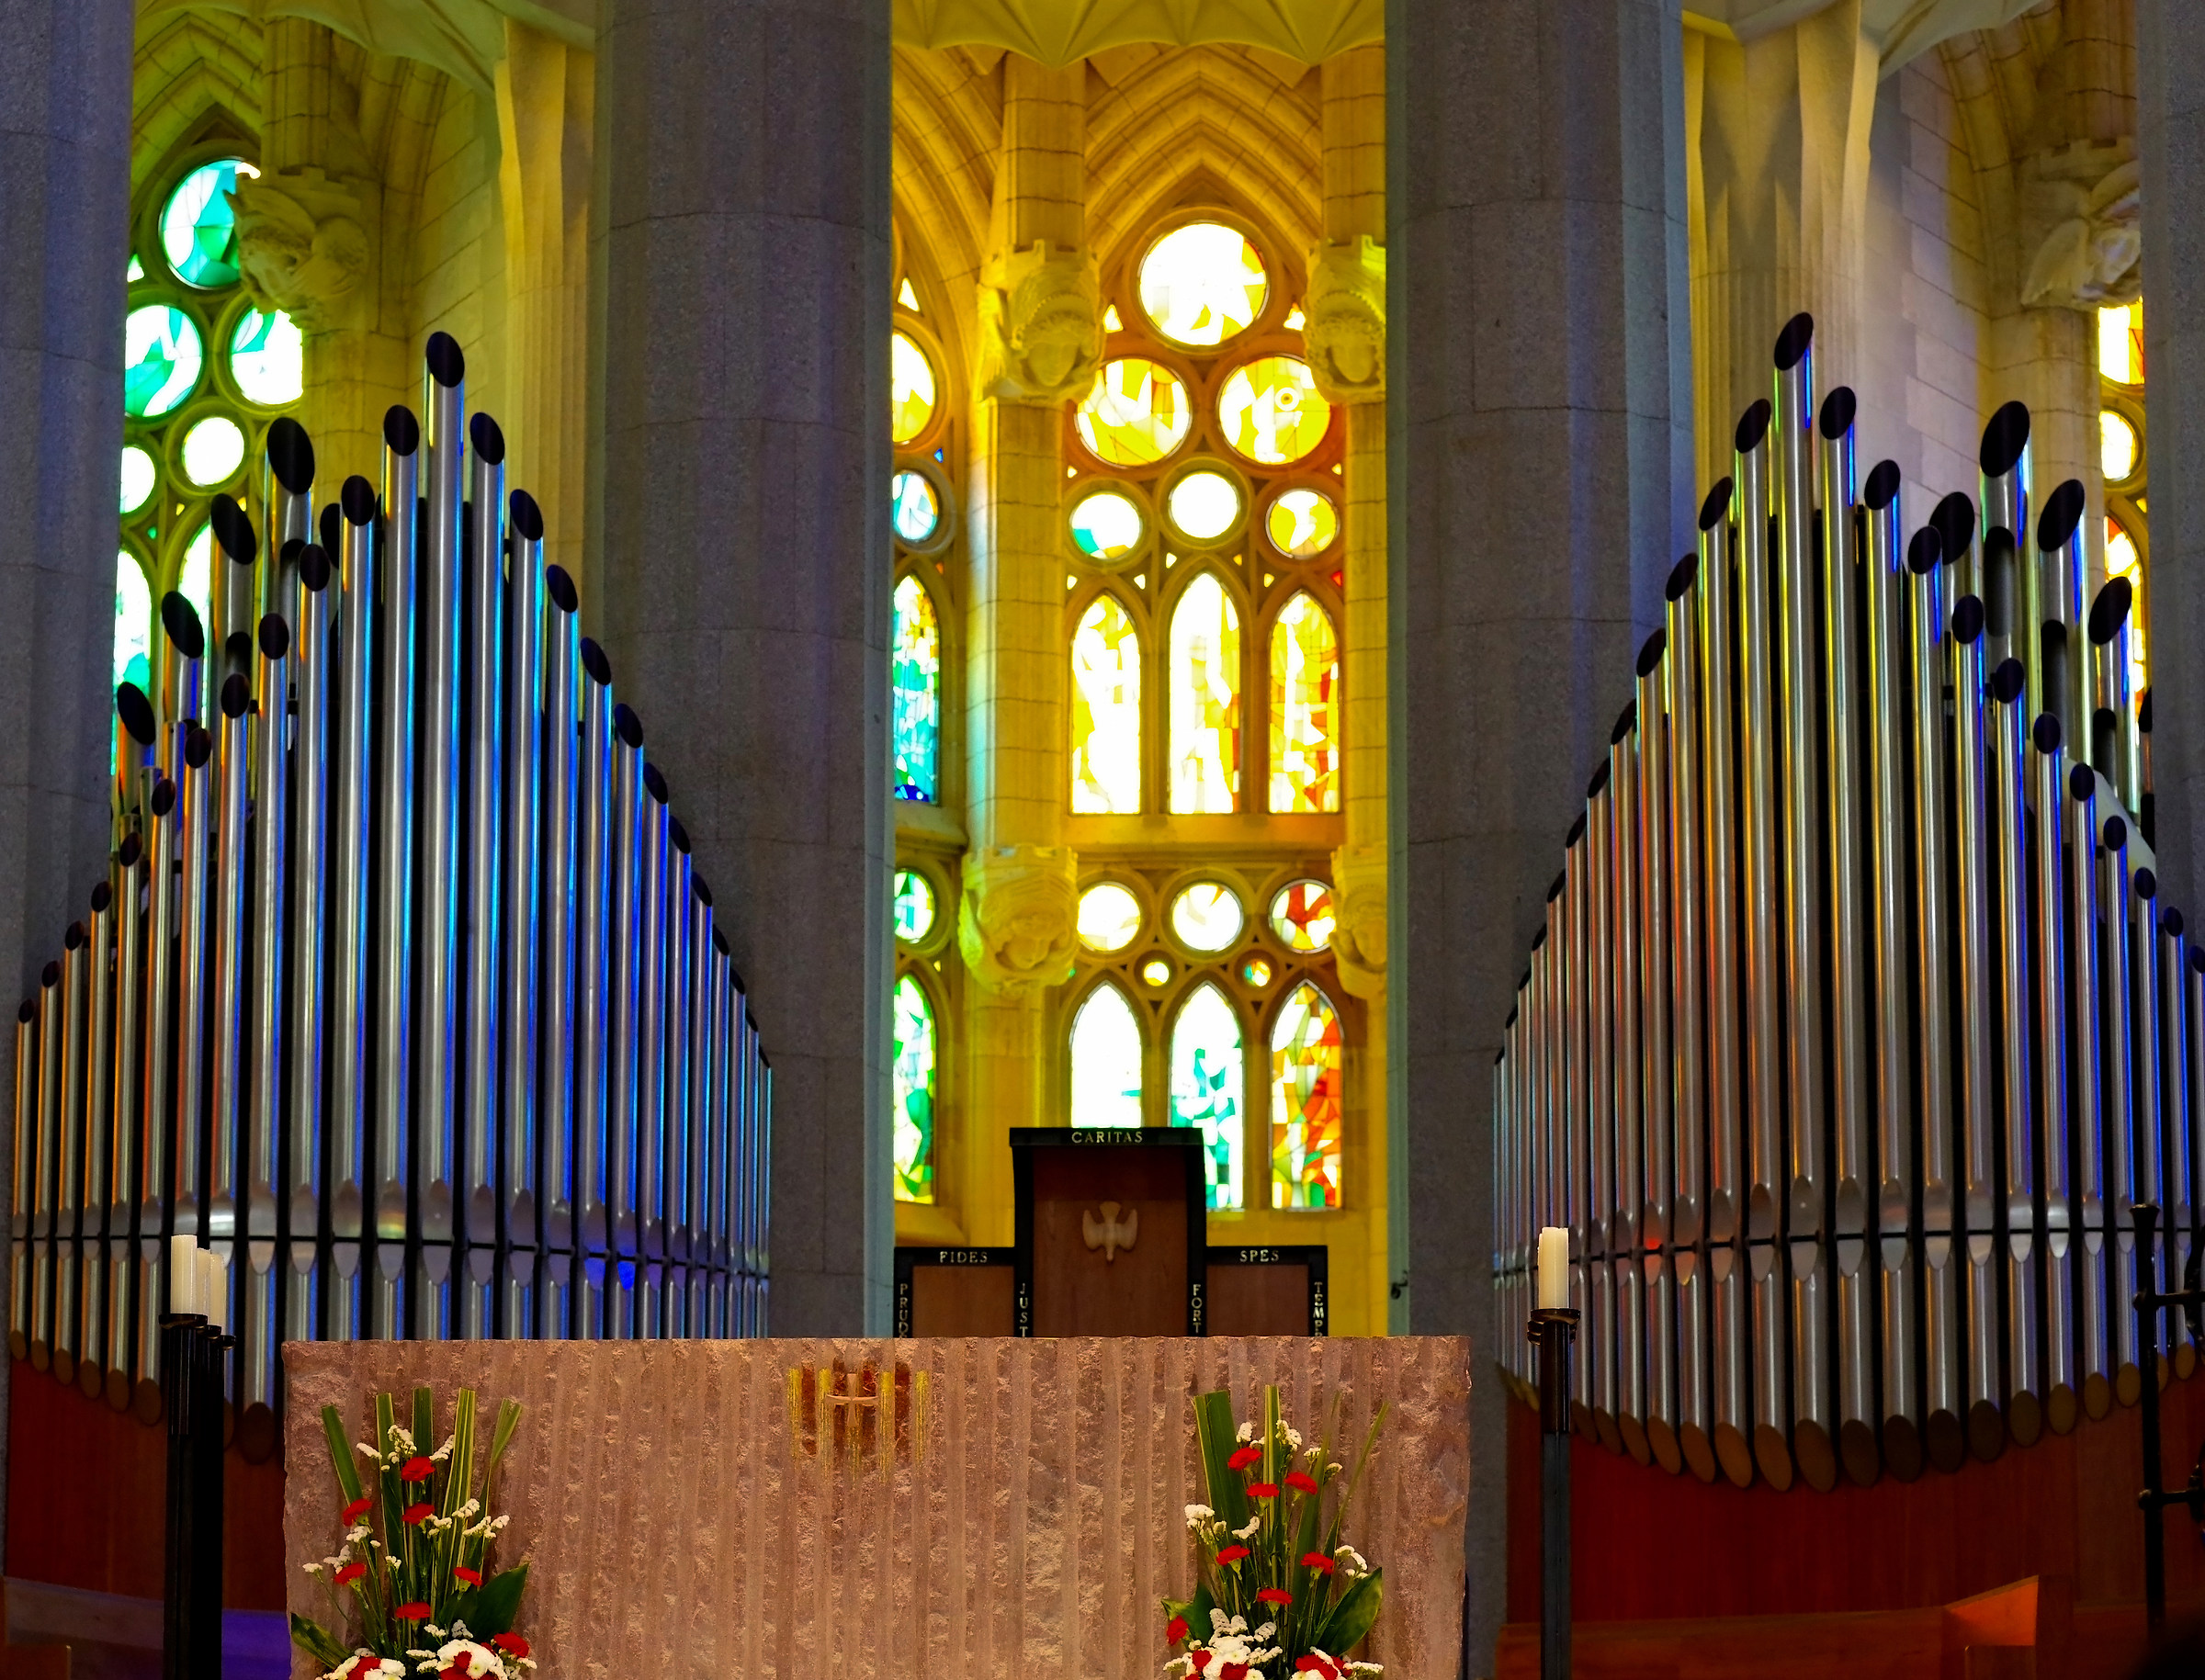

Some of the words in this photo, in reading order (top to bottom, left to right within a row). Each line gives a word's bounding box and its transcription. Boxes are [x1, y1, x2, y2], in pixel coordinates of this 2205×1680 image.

[1071, 1131, 1143, 1144] CARITAS
[939, 1250, 988, 1264] FIDES
[1239, 1248, 1280, 1263] SPES
[1191, 1283, 1203, 1334] FORT
